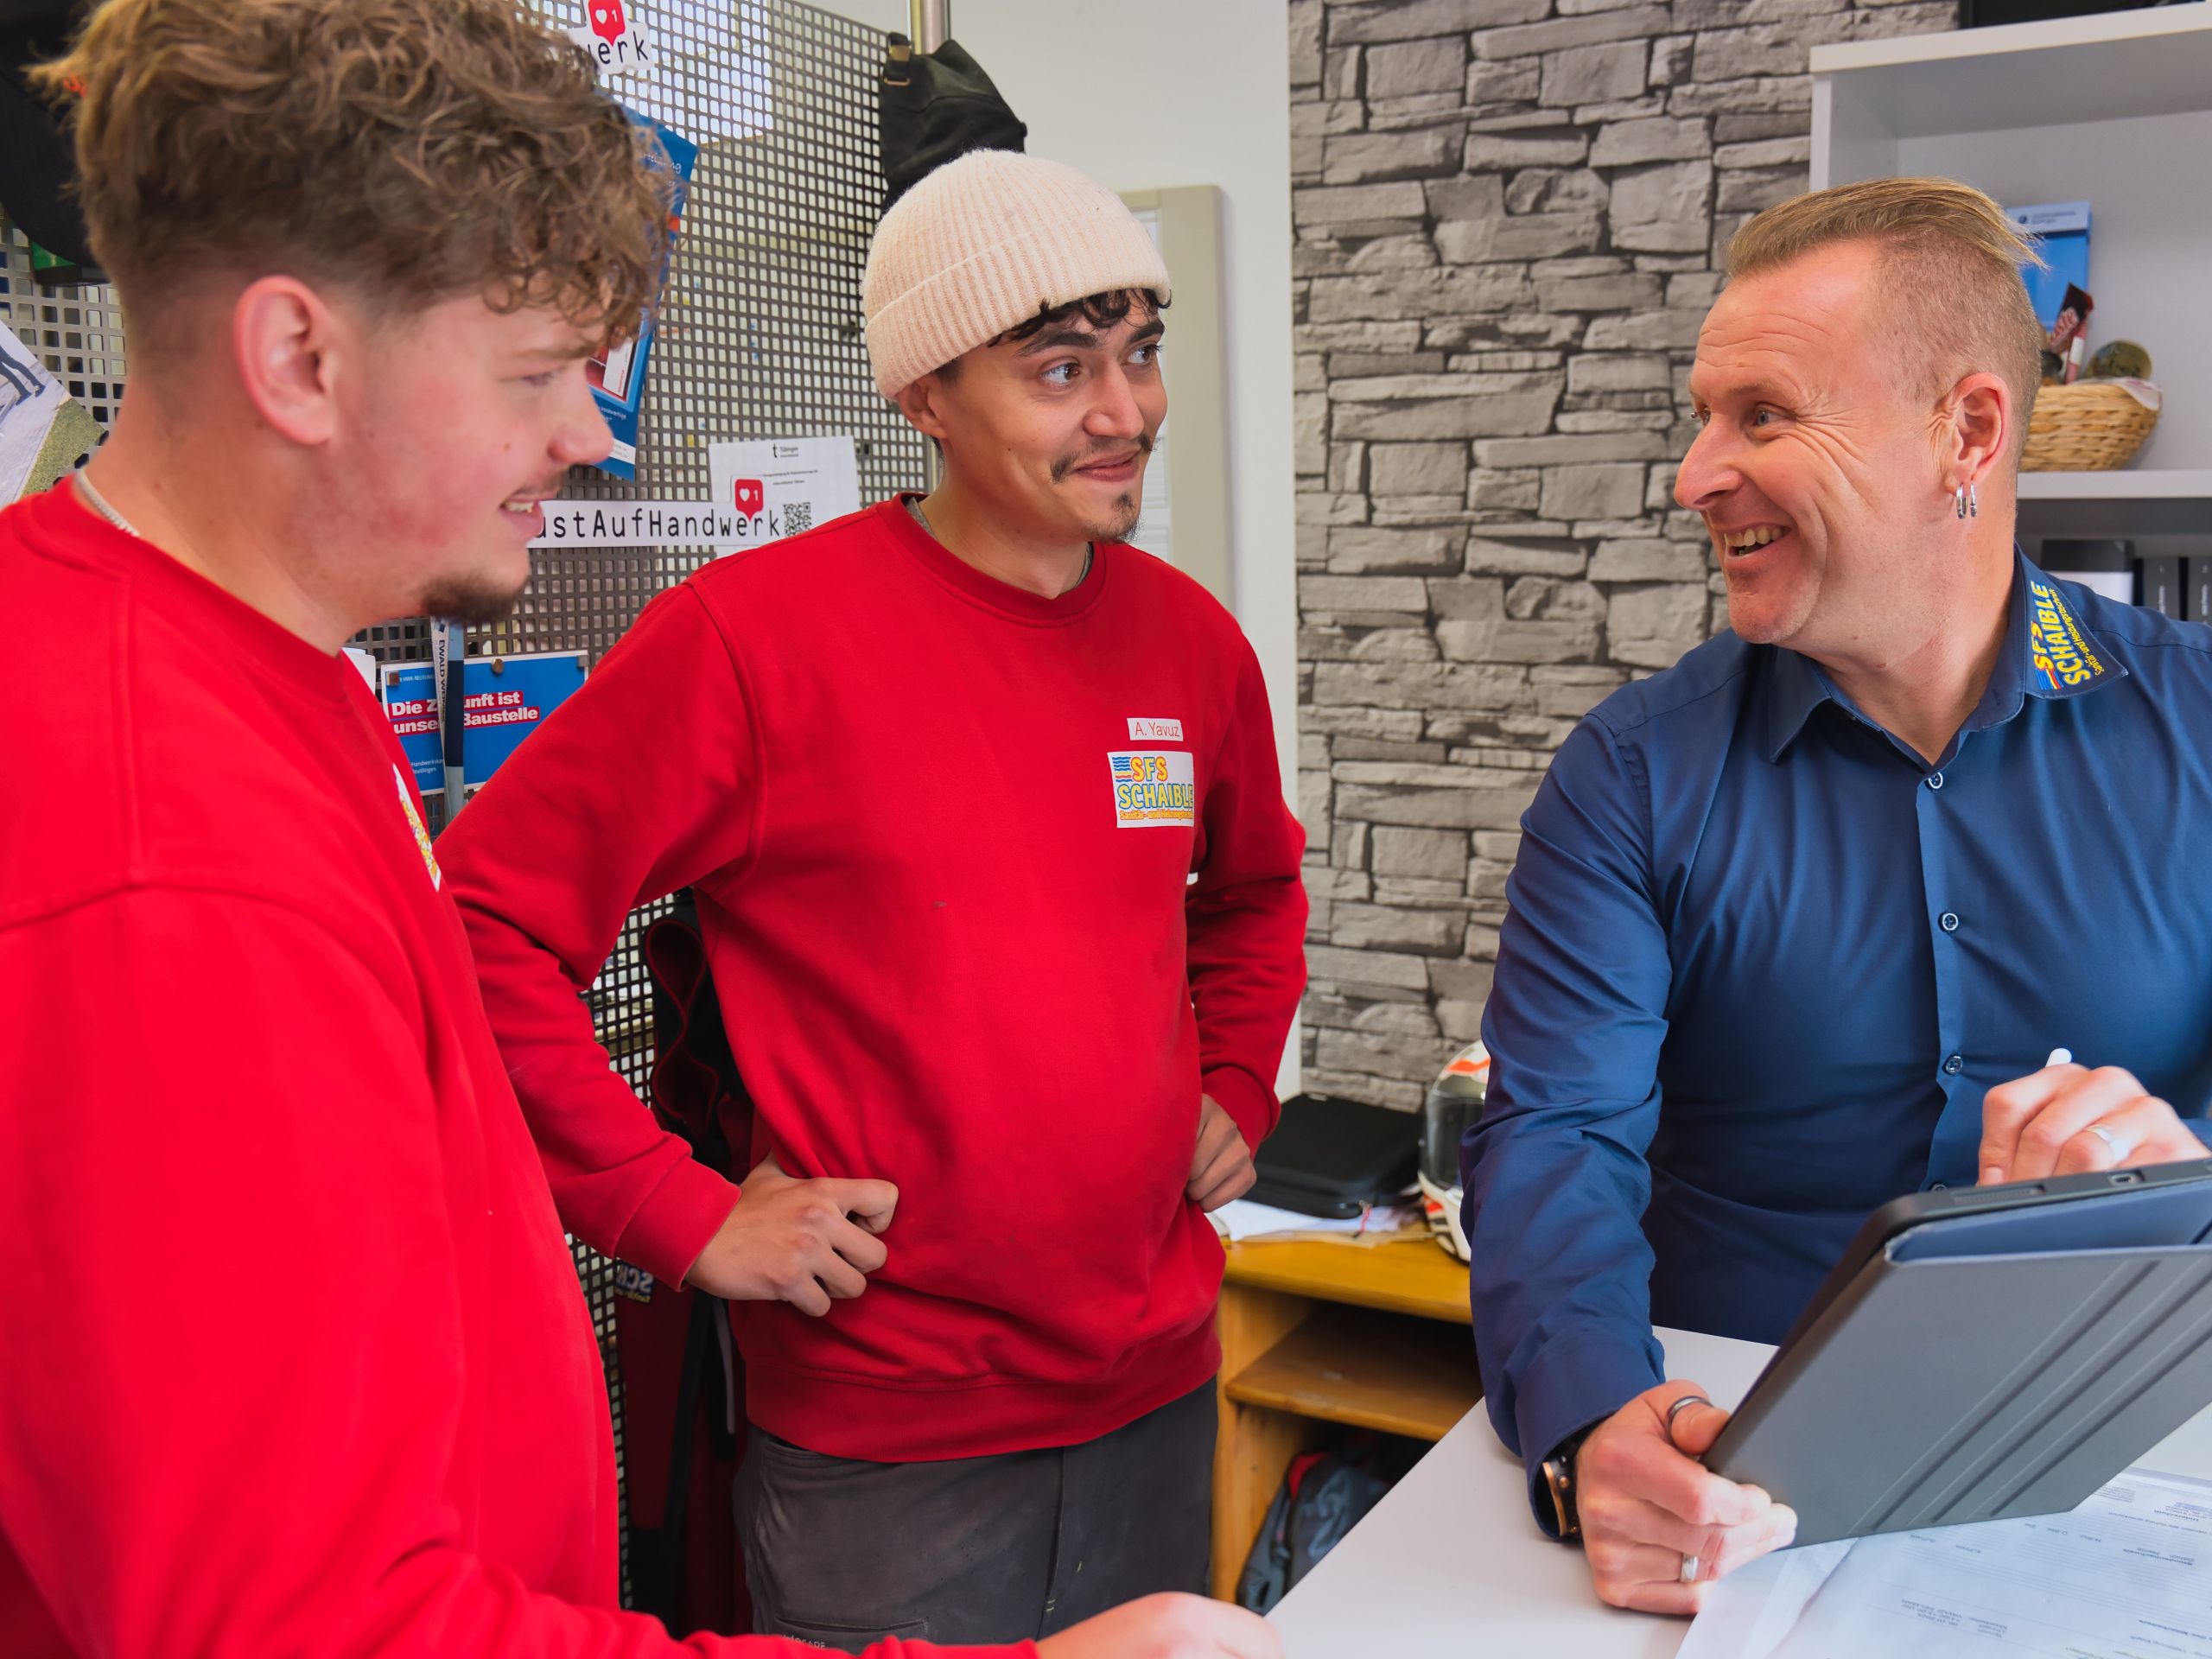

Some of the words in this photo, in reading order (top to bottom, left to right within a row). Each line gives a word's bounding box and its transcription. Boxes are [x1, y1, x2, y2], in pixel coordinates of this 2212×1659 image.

[588, 30, 648, 64] erk
[2031, 581, 2091, 684] SCHAIBLE
[391, 702, 423, 715] Die
[498, 692, 520, 705] ist
[1135, 721, 1147, 735] A.
[1148, 721, 1180, 737] Yavuz
[1130, 756, 1168, 782] SFS
[1117, 783, 1193, 810] SCHAIBLE
